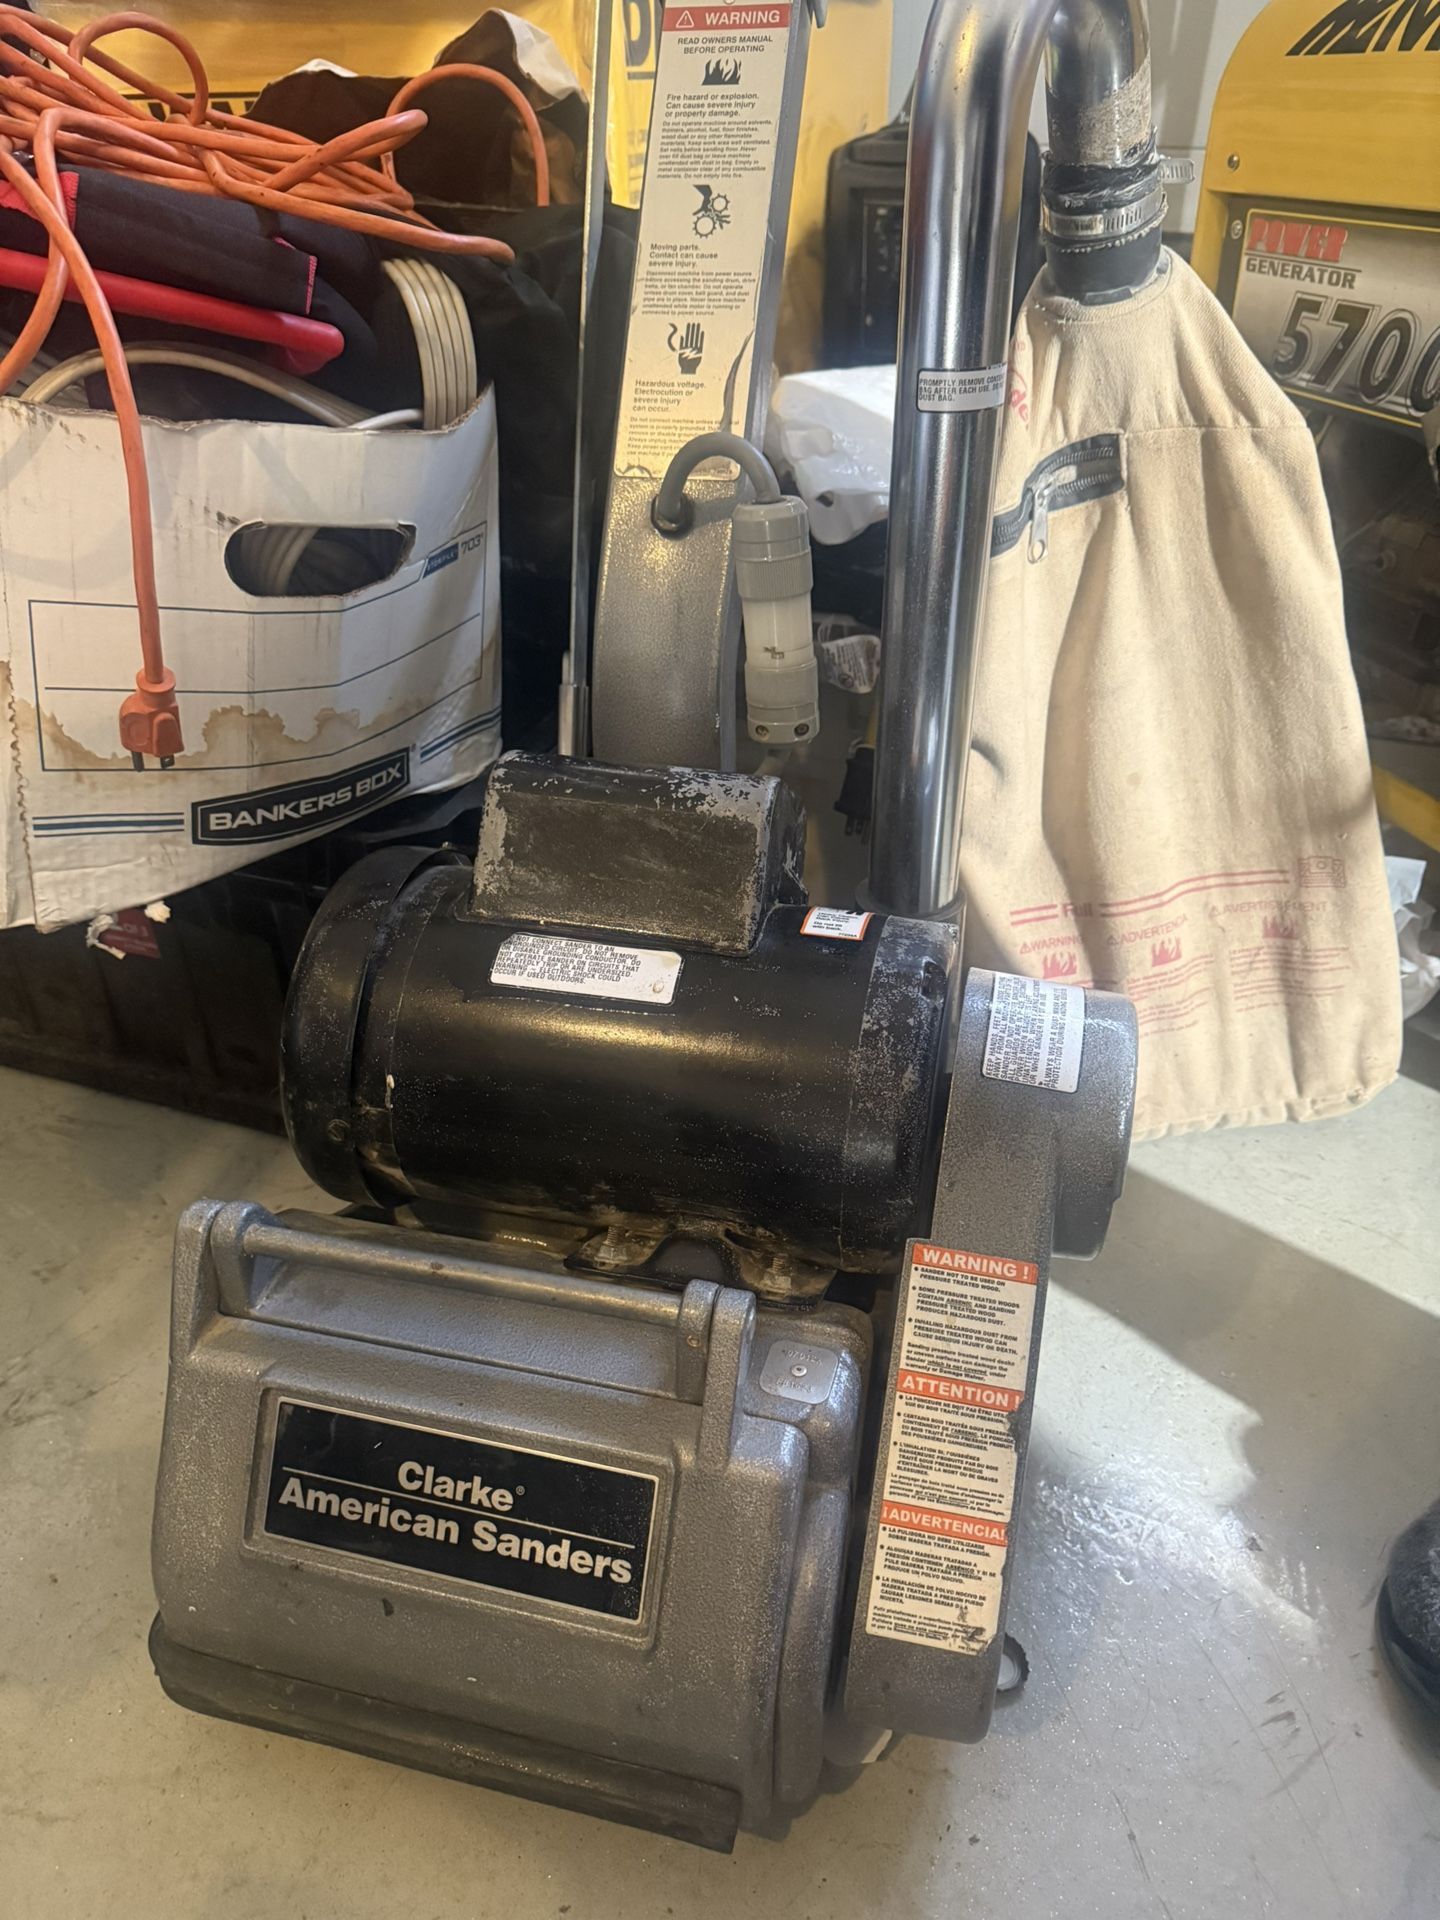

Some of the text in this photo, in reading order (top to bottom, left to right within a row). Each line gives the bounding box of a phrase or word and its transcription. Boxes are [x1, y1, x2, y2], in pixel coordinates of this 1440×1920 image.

[704, 10, 780, 24] WARNING
[701, 36, 737, 44] OWNERS
[738, 35, 773, 43] MANUAL
[717, 45, 764, 53] OPERATING
[734, 101, 755, 109] injury
[674, 110, 706, 118] property
[707, 109, 740, 117] damage.
[650, 243, 677, 251] Moving
[649, 251, 678, 259] Contact
[1246, 257, 1357, 289] GENERATOR
[635, 379, 705, 389] Hazardous voltage.
[934, 387, 956, 395] AFTER
[959, 386, 976, 395] EACH
[634, 386, 683, 397] Electrocution
[919, 393, 935, 401] DUST
[209, 762, 402, 831] BANKERS BOX
[505, 939, 550, 949] NGROUNDED
[610, 951, 637, 960] REMOVE
[531, 937, 562, 945] CONNECT
[564, 941, 591, 949] SANDER
[512, 946, 539, 954] DISABLE
[542, 949, 582, 959] GROUNDING
[497, 955, 539, 966] REPEATEDLY
[514, 952, 544, 960] OPERATE
[547, 956, 574, 964] SANDER
[588, 961, 619, 970] CIRCUITS
[493, 966, 516, 975] OCCUR
[526, 971, 545, 979] USED
[495, 961, 620, 982] WARNING ELECTRIC SHOCK COULD
[921, 1248, 1029, 1279] WARNING !
[920, 1267, 944, 1275] SANDER
[919, 1273, 1000, 1292] PRESSURE TREATED WOOD.
[937, 1289, 967, 1299] PRESSURE
[969, 1295, 996, 1304] TREATED
[997, 1300, 1019, 1308] WOODS
[916, 1299, 995, 1317] PRESSURE TREATED WOOD
[913, 1325, 944, 1335] PRESSURE
[946, 1330, 973, 1340] TREATED
[974, 1335, 992, 1343] WOOD
[903, 1375, 1019, 1408] ATTENTION !
[882, 1506, 1005, 1540] ¡ADVERTENCIA!
[278, 1476, 632, 1584] American Sanders
